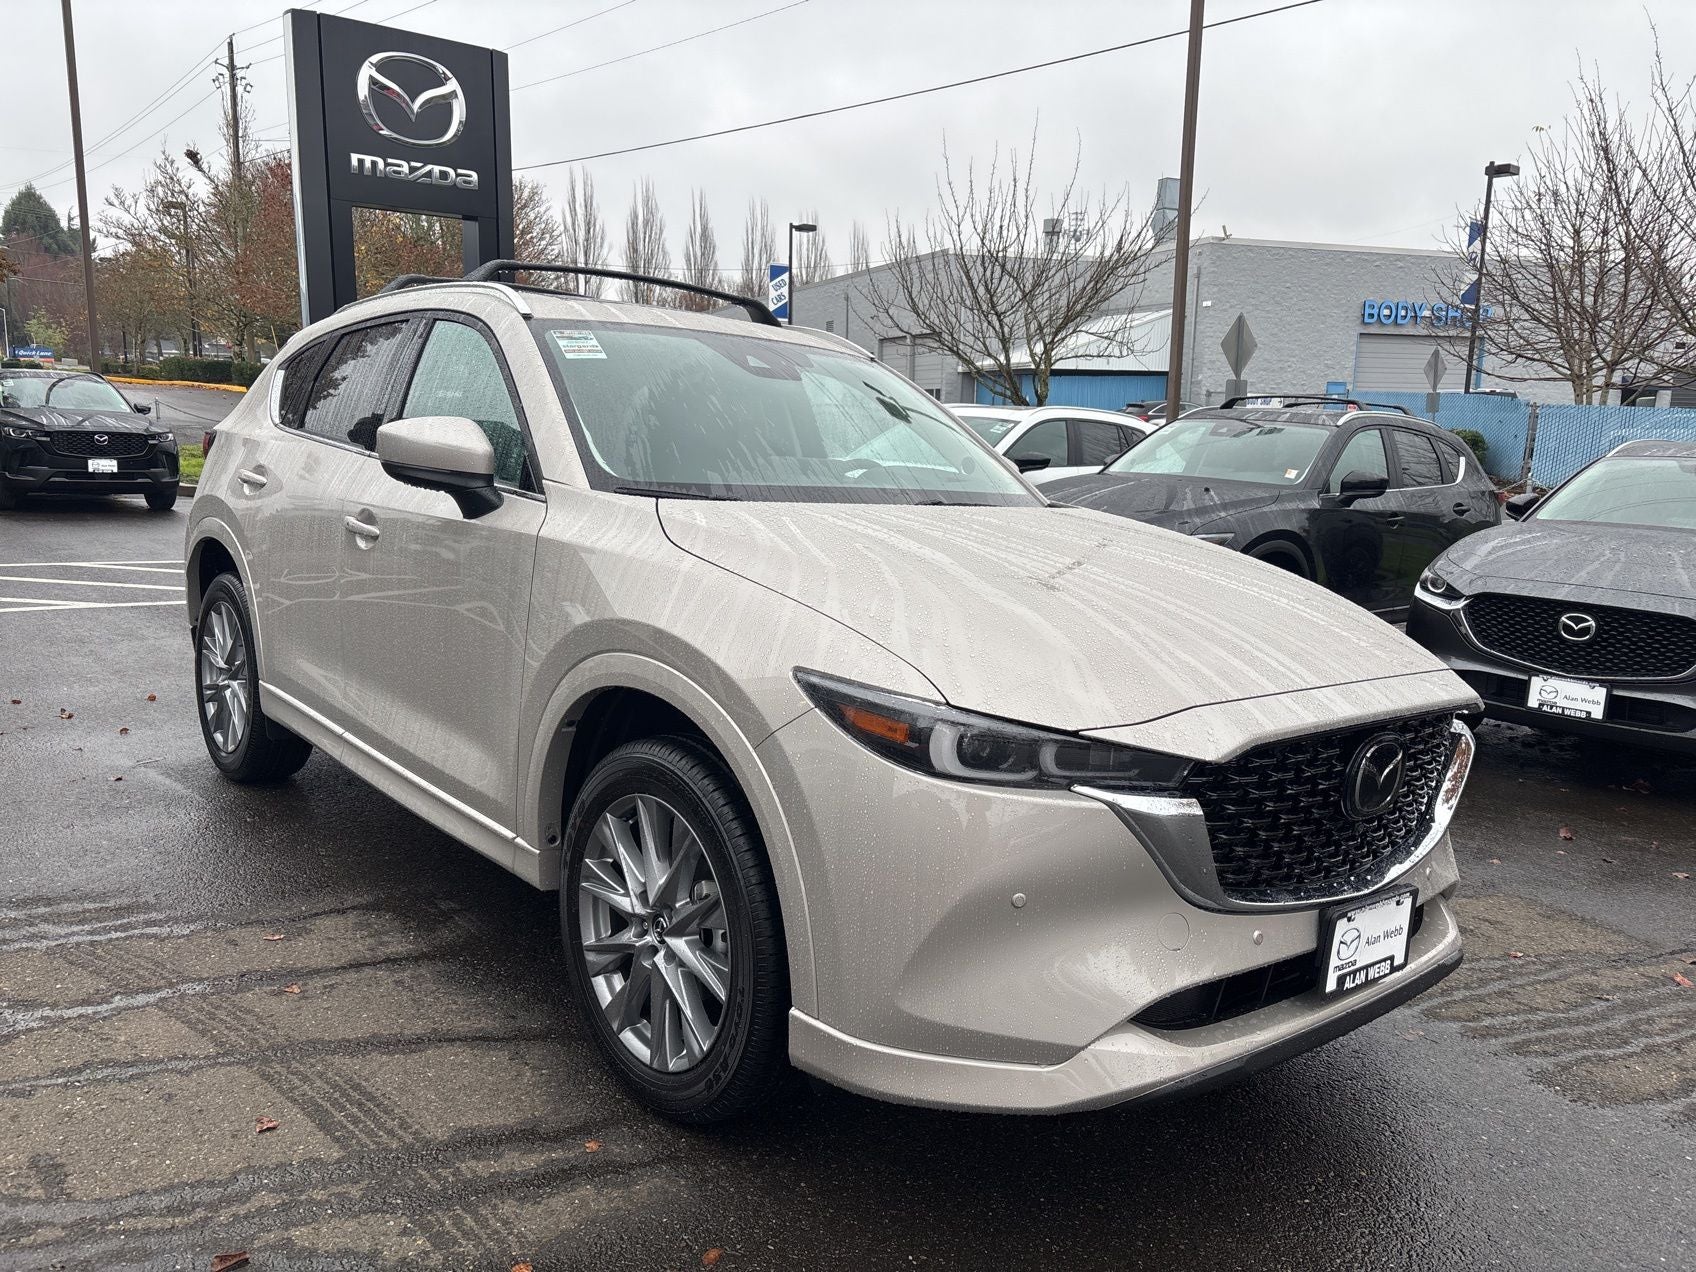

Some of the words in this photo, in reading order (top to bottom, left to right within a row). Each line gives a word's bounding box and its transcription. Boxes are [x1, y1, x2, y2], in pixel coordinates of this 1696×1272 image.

[350, 152, 479, 190] mazda
[771, 278, 787, 292] USED
[771, 292, 787, 305] CARS
[1363, 299, 1427, 325] BODY
[1431, 303, 1493, 330] SHP
[1563, 694, 1579, 703] Alan
[1580, 697, 1601, 706] Webb
[1541, 704, 1562, 714] ALAN
[1564, 707, 1587, 718] WEBB
[1364, 933, 1381, 948] Alan
[1383, 924, 1404, 940] Webb
[1333, 959, 1357, 974] mazda
[1343, 968, 1367, 991] ALAN
[1367, 959, 1391, 981] WEBB
